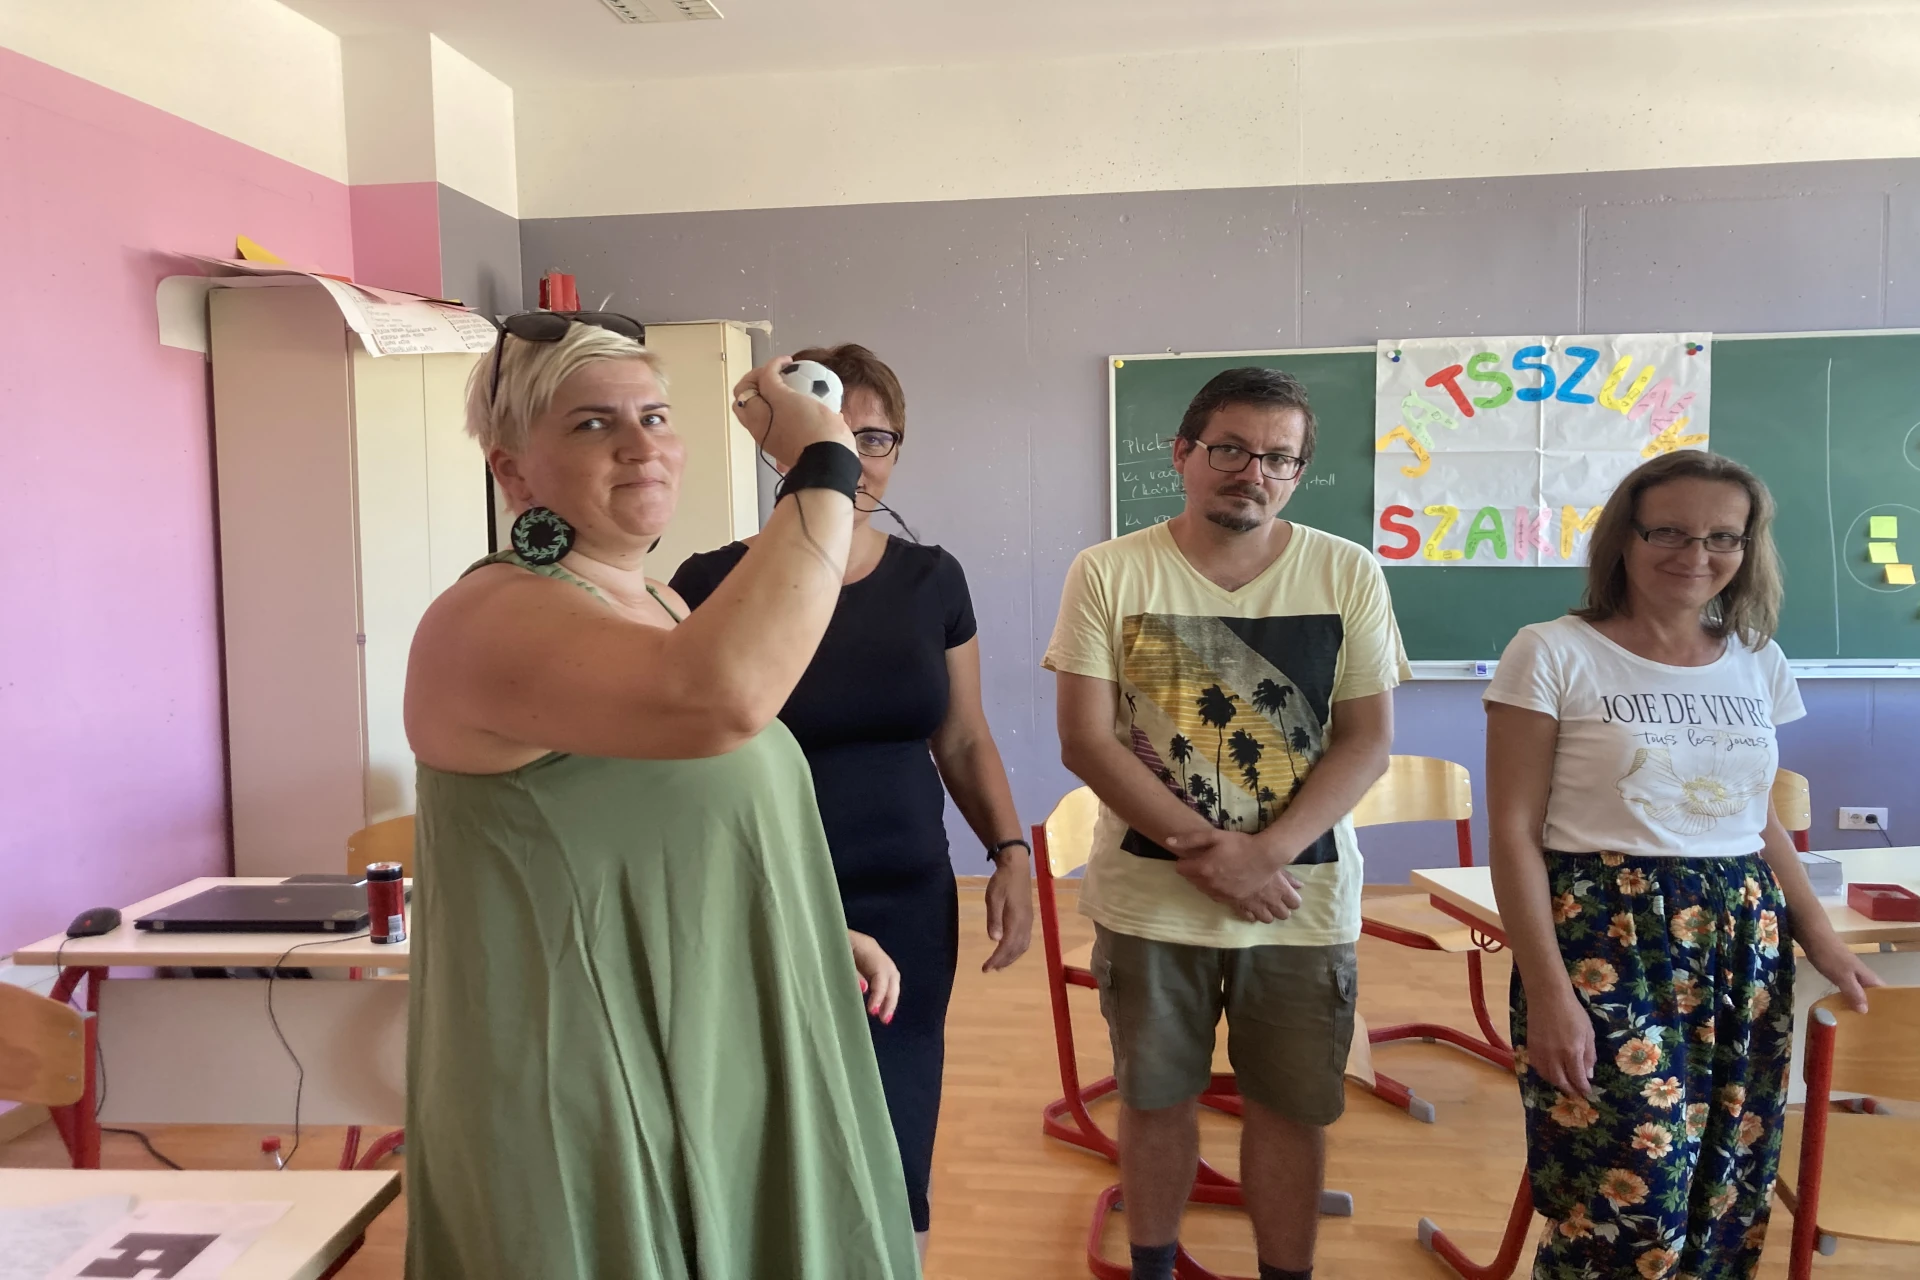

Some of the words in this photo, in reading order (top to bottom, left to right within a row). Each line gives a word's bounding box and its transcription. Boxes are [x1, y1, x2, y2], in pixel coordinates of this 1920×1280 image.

[1600, 693, 1662, 724] JOIE
[1661, 693, 1702, 725] DE
[1700, 694, 1772, 730] VIVRE
[1632, 731, 1678, 746] tous
[1687, 728, 1717, 748] les
[1726, 734, 1769, 752] jours
